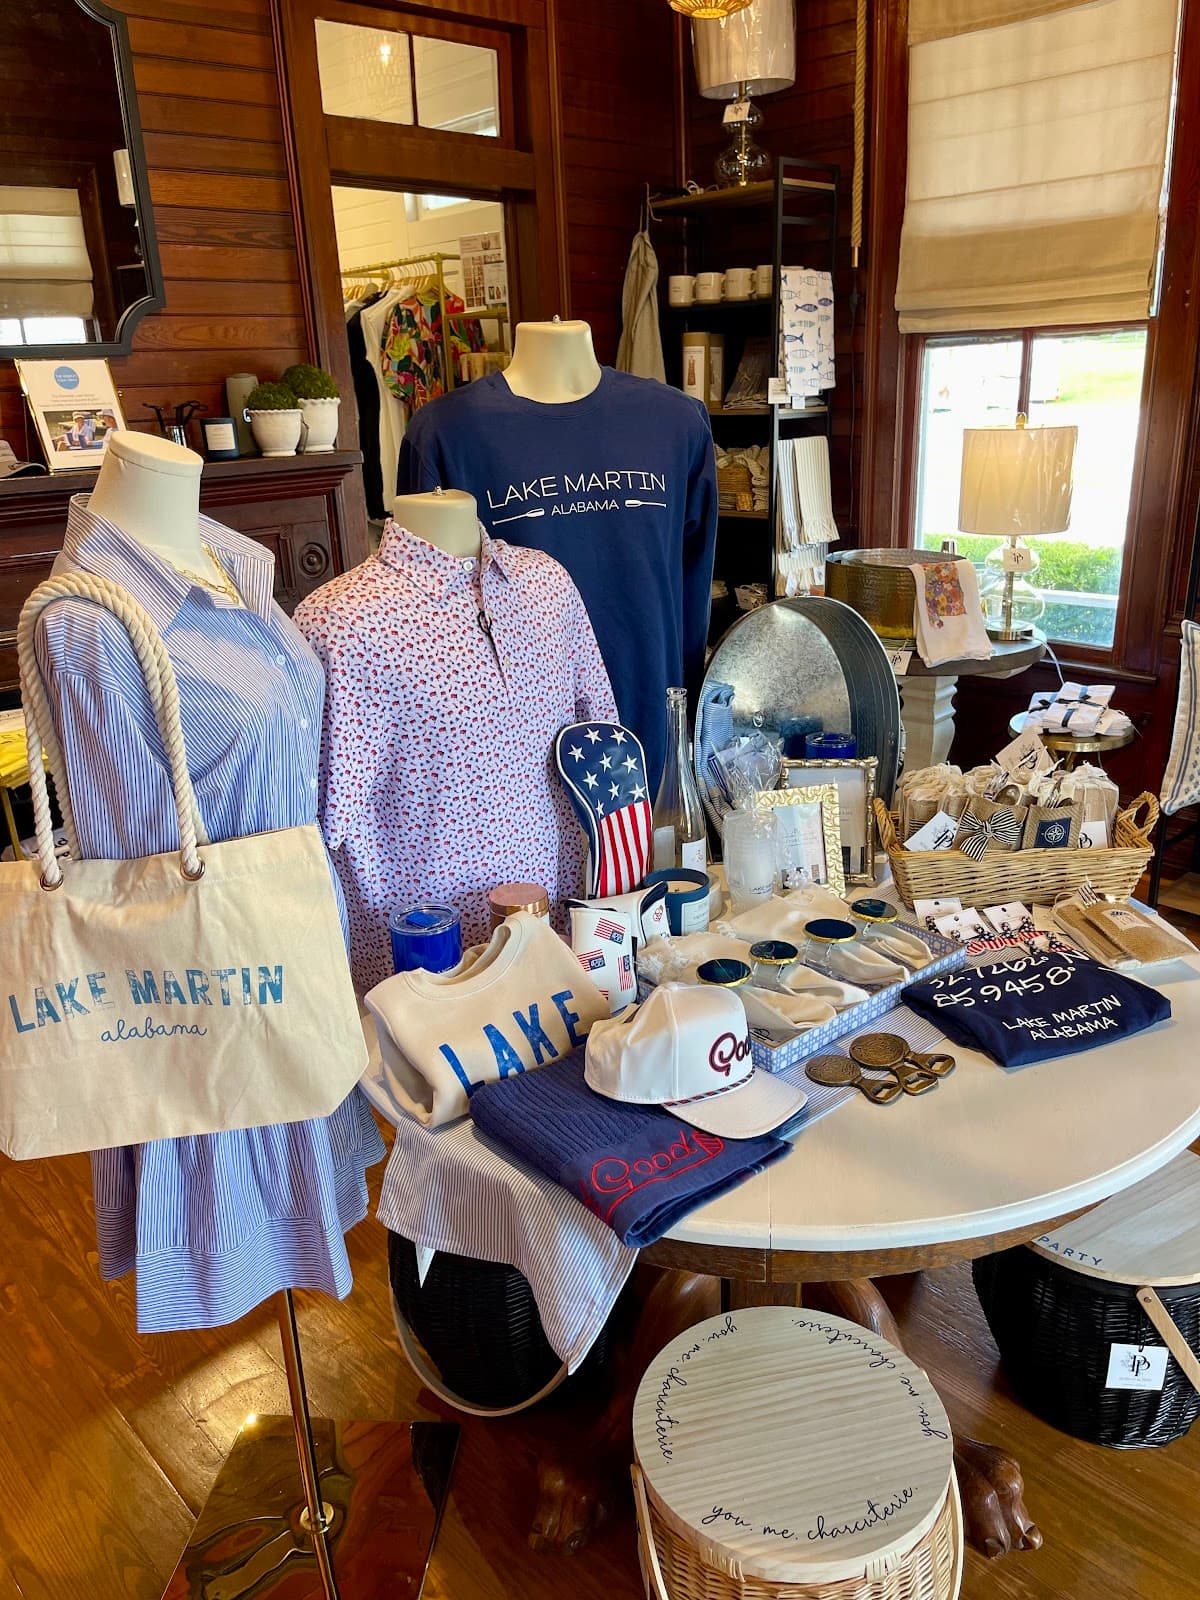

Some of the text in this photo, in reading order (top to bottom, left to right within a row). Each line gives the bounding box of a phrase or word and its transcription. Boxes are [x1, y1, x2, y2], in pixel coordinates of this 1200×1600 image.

[486, 470, 666, 509] LAKE MARTIN
[551, 499, 619, 517] ALABAMA
[8, 965, 283, 1034] LAKE MARTIN
[1002, 994, 1122, 1030] LAKE MARTIN
[100, 1016, 208, 1042] alabama
[438, 989, 590, 1099] LAKE
[1031, 1016, 1119, 1041] ALABAMA
[1037, 1236, 1103, 1266] PARTY
